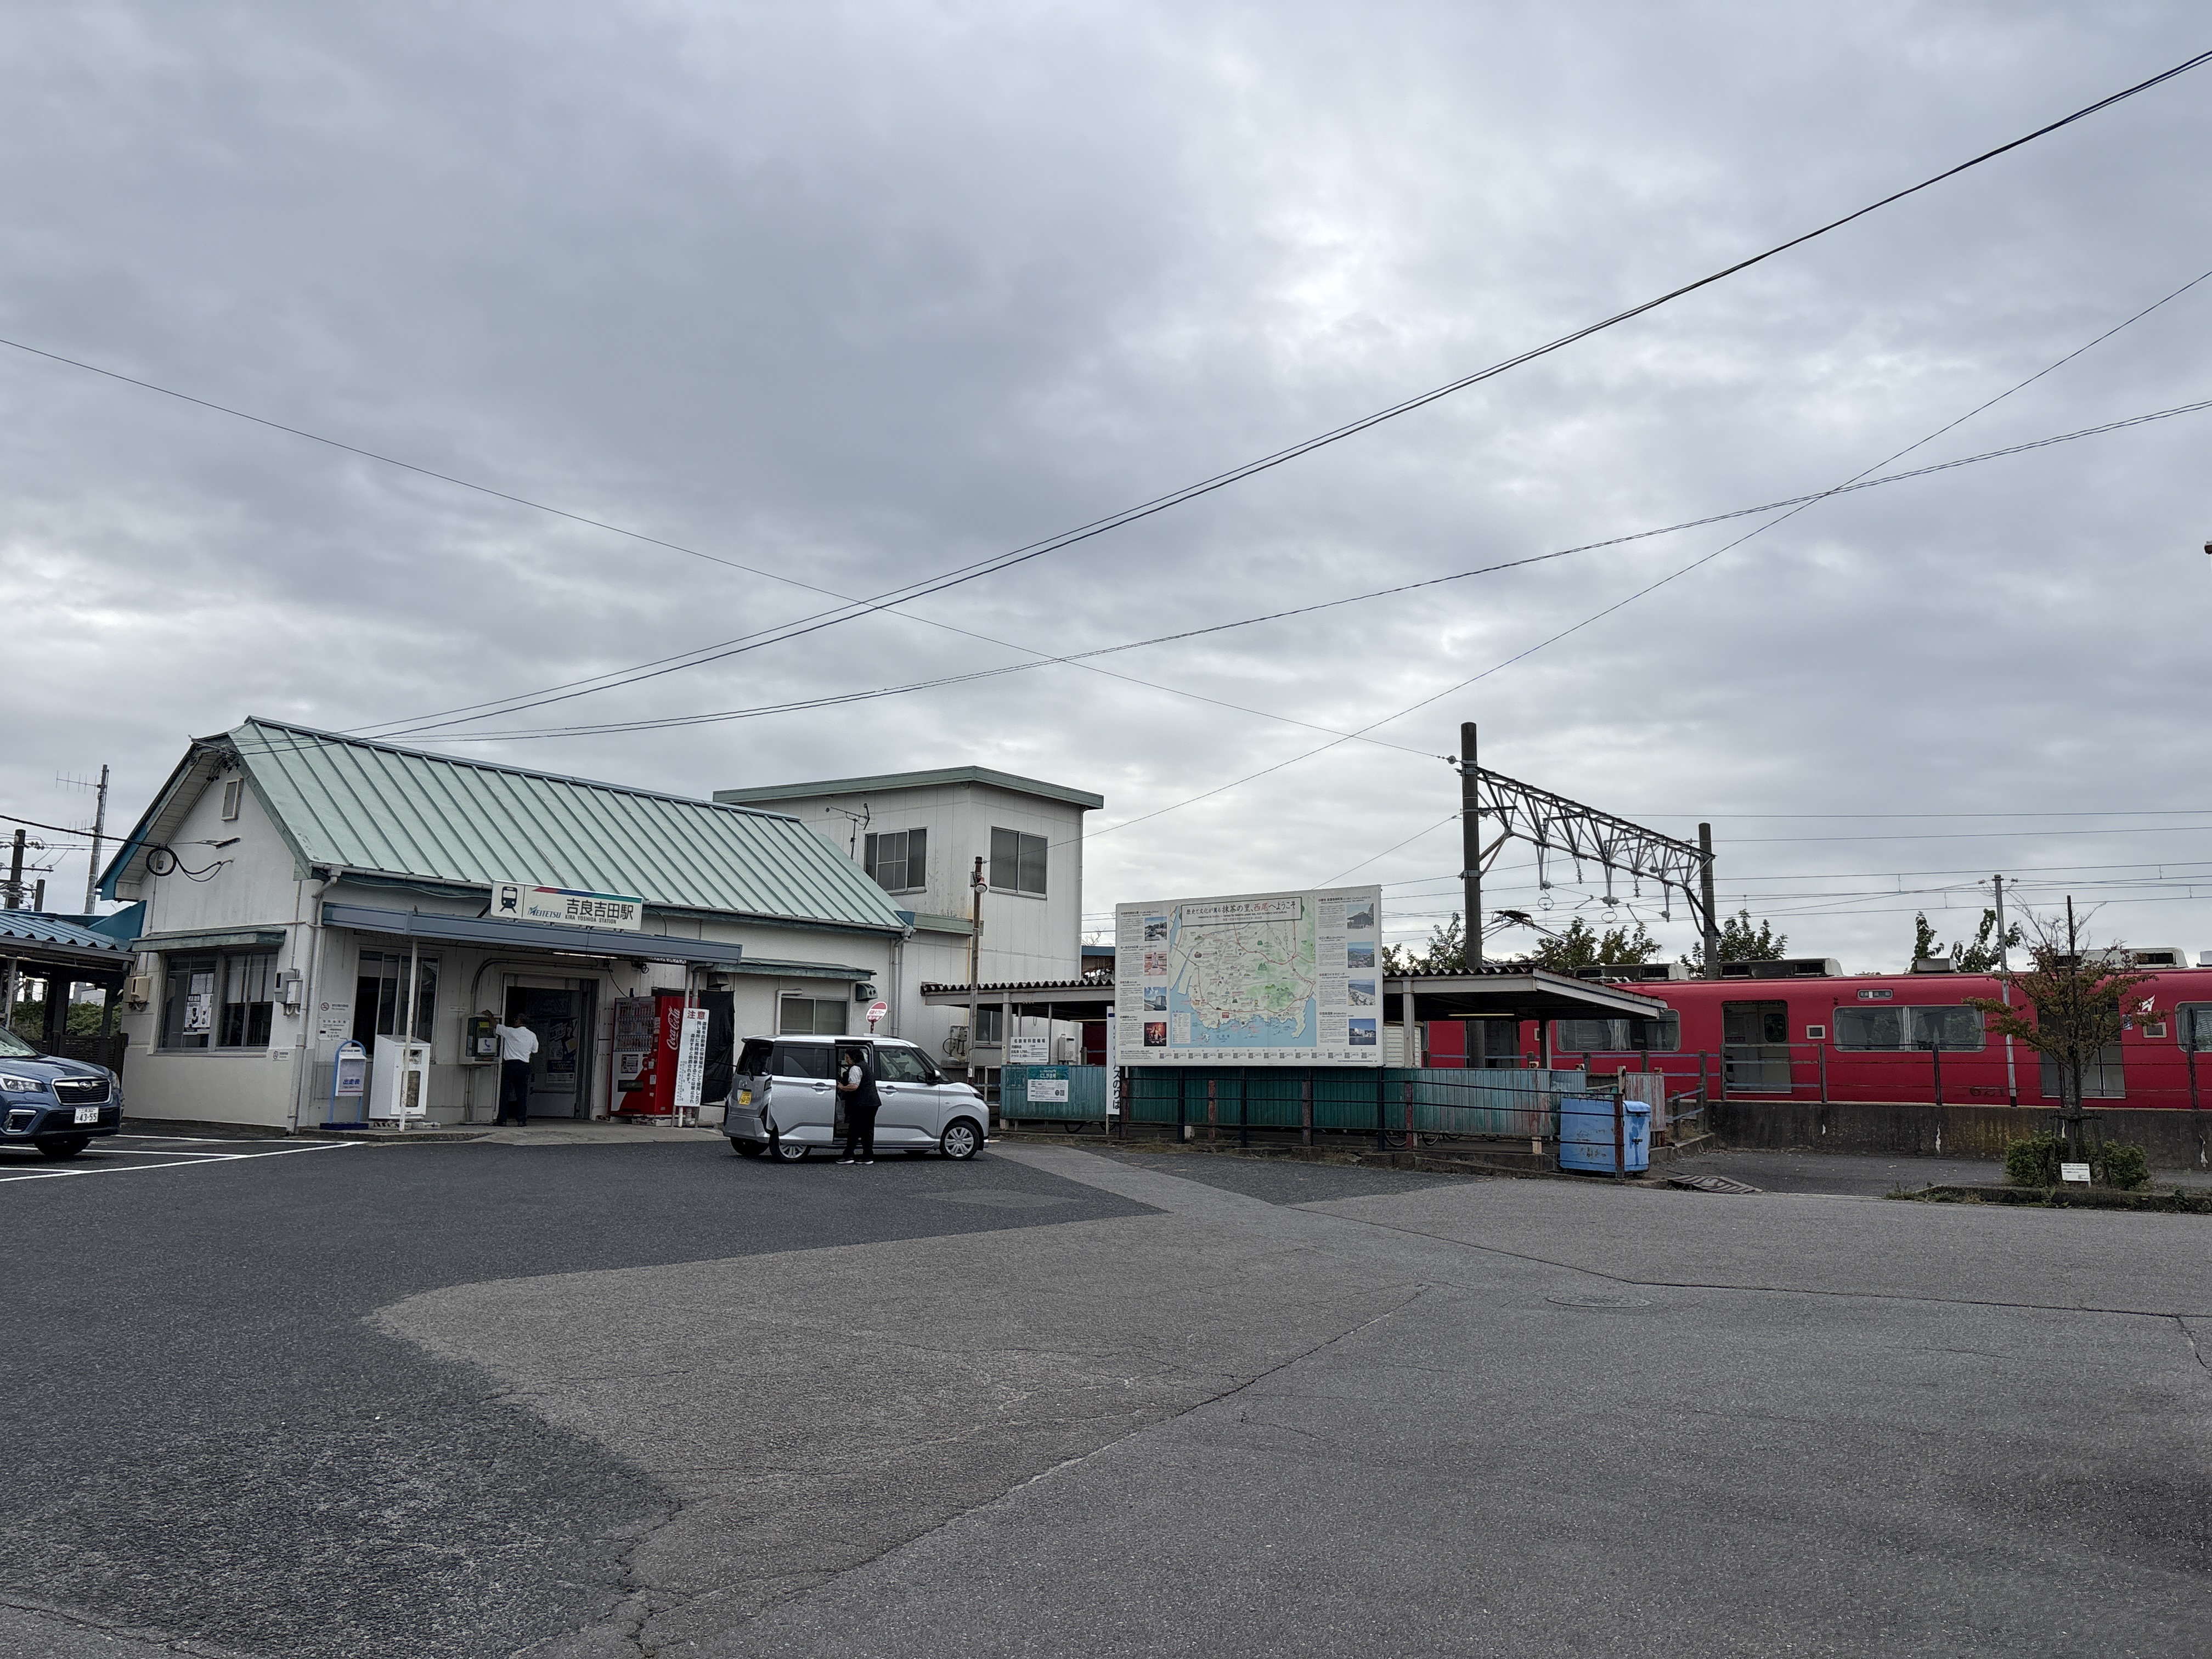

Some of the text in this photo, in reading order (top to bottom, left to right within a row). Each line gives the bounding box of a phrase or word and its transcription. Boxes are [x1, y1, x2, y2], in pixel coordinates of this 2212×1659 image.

[527, 904, 561, 919] MEITETSU
[566, 898, 634, 920] 吉良吉田駅
[687, 1010, 706, 1020] 注意
